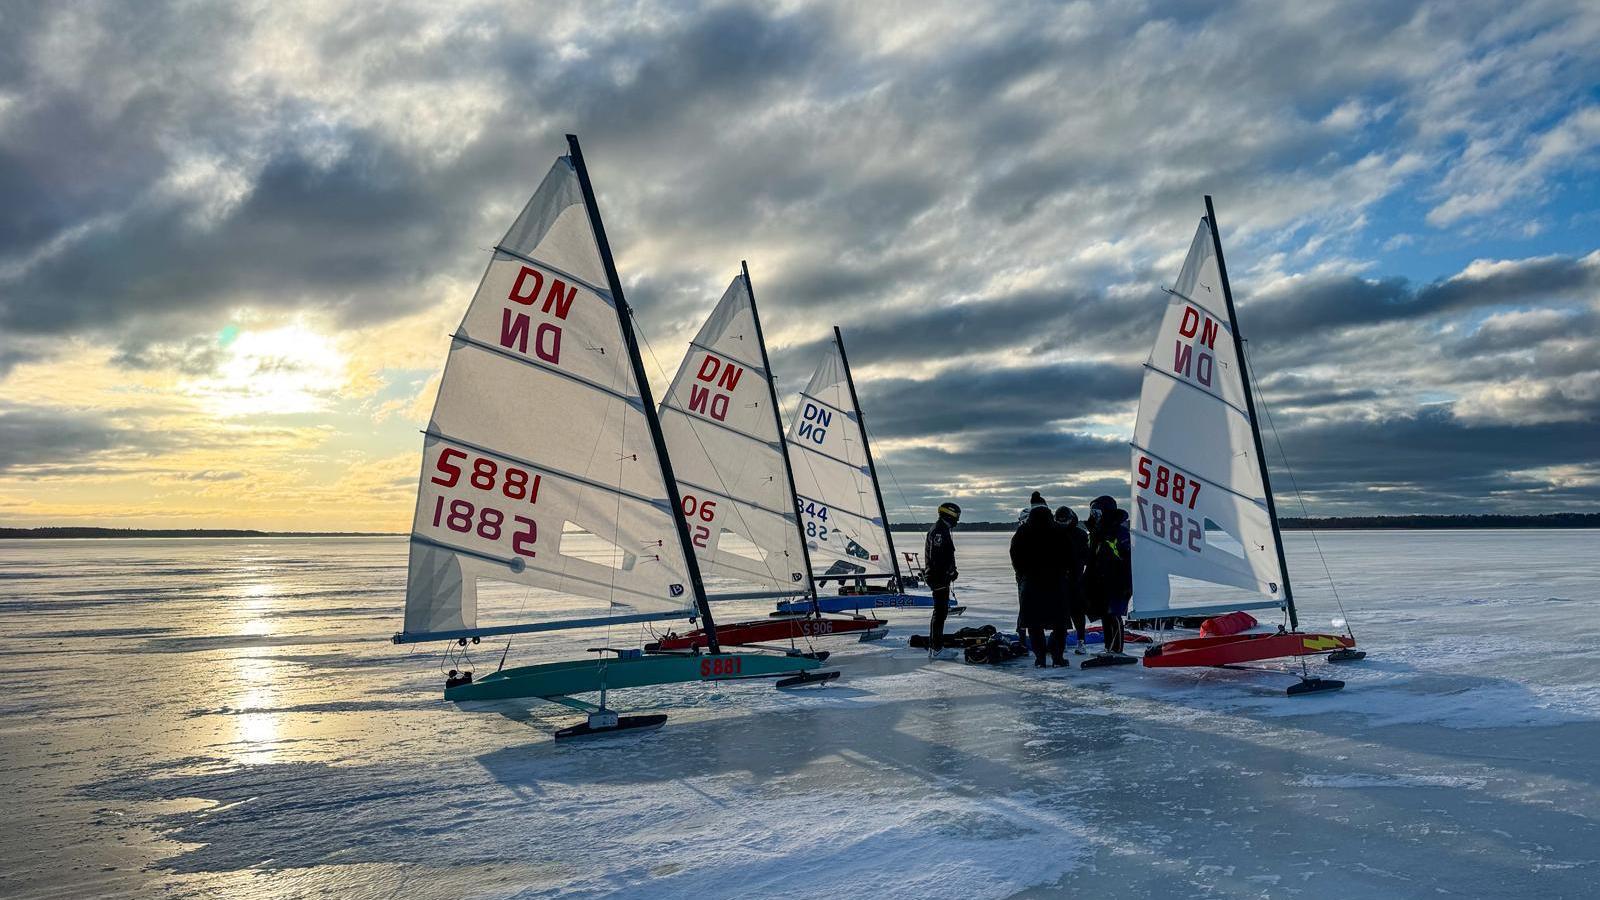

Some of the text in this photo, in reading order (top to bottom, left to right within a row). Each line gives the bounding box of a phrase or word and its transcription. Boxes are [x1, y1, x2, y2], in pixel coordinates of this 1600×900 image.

[508, 265, 578, 321] DN
[1179, 305, 1219, 351] DN
[696, 354, 744, 392] DN
[803, 403, 832, 428] DN
[813, 621, 833, 634] 906
[700, 656, 742, 677] S881
